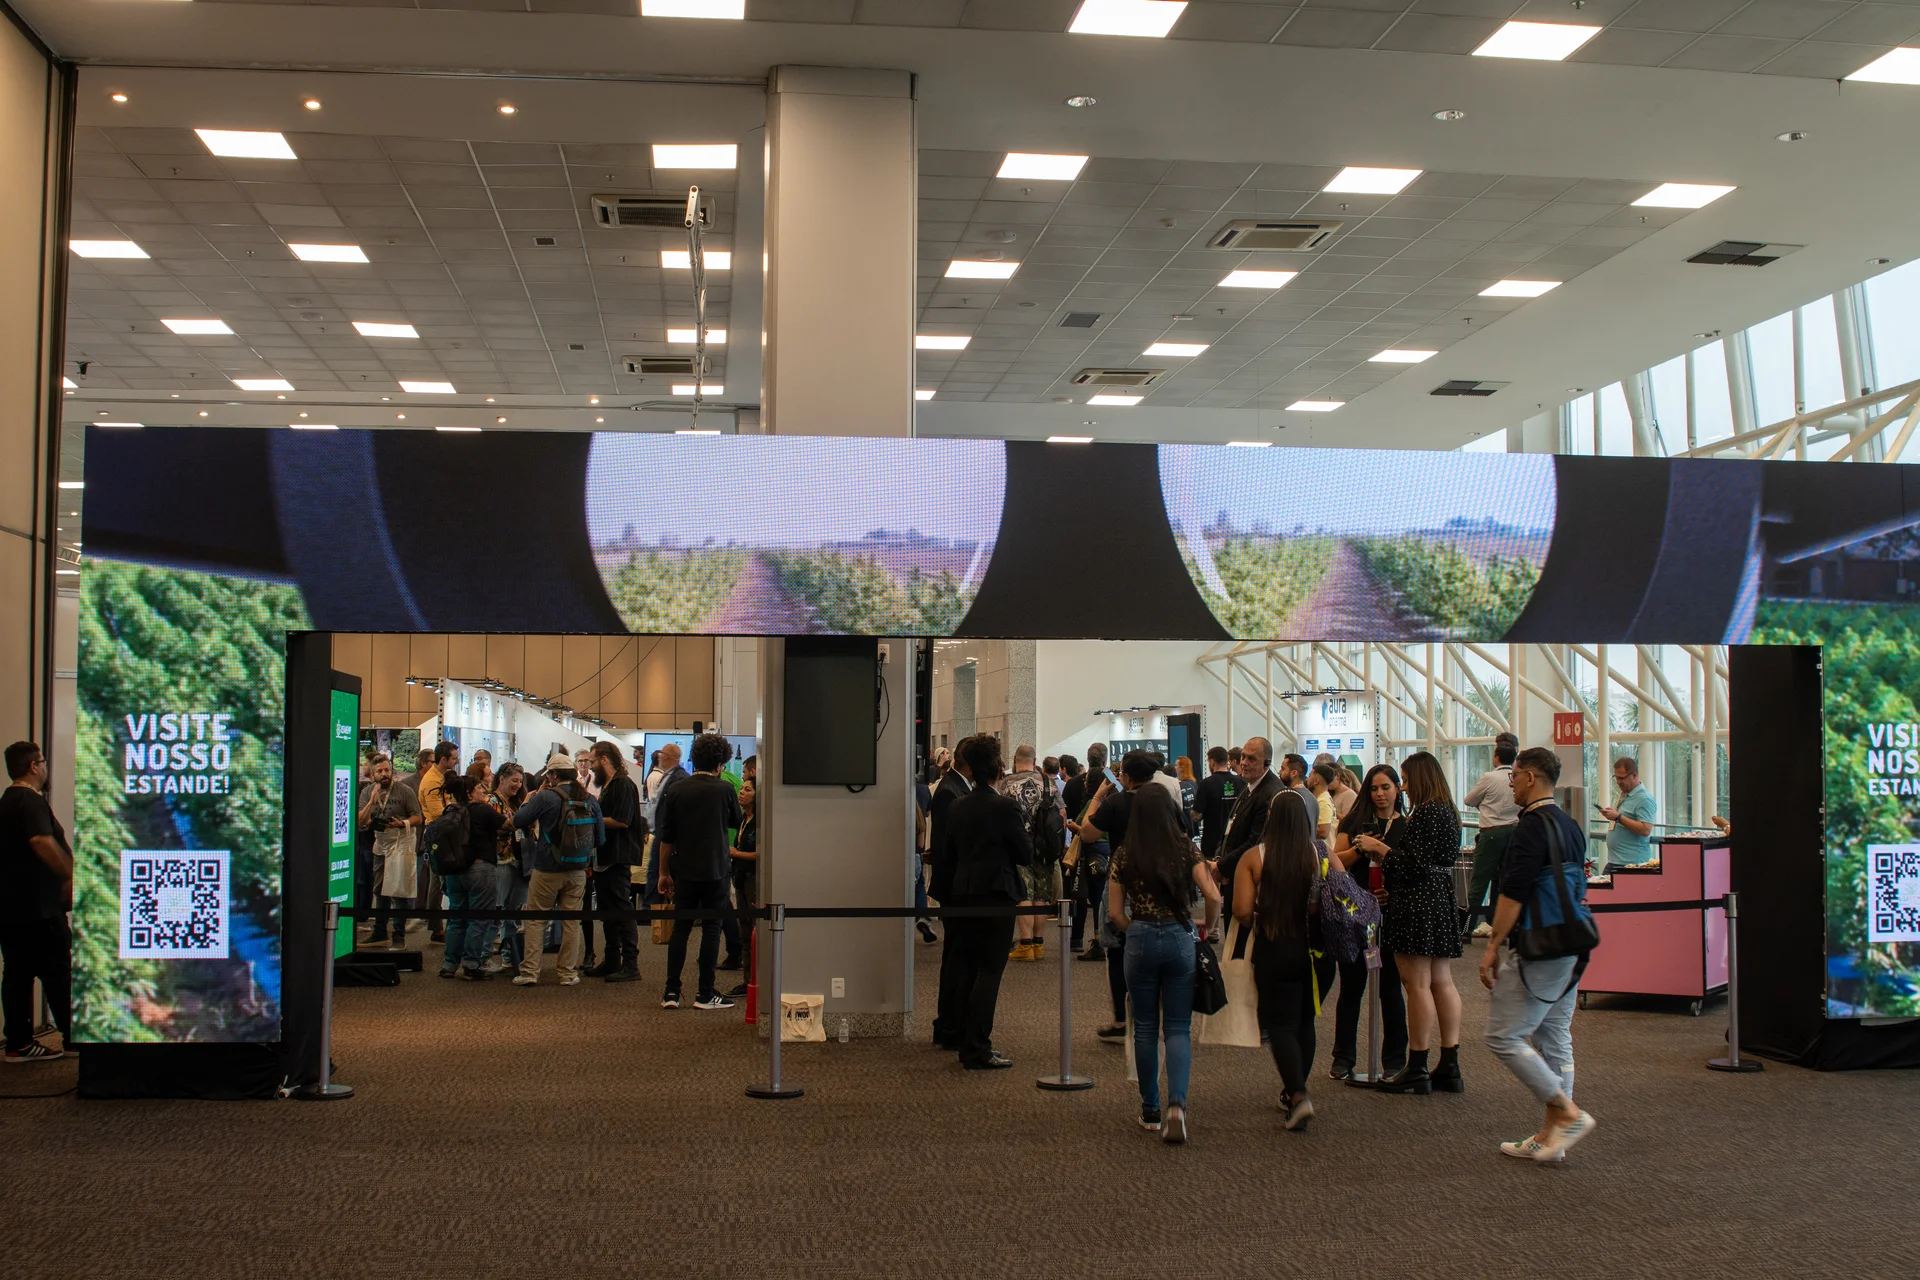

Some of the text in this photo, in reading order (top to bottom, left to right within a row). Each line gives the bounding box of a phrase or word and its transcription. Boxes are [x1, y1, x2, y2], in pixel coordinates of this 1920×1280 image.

[1329, 698, 1347, 714] aura
[125, 713, 231, 741] VISITE
[125, 743, 231, 770] NOSSO
[124, 775, 230, 794] ESTANDE!
